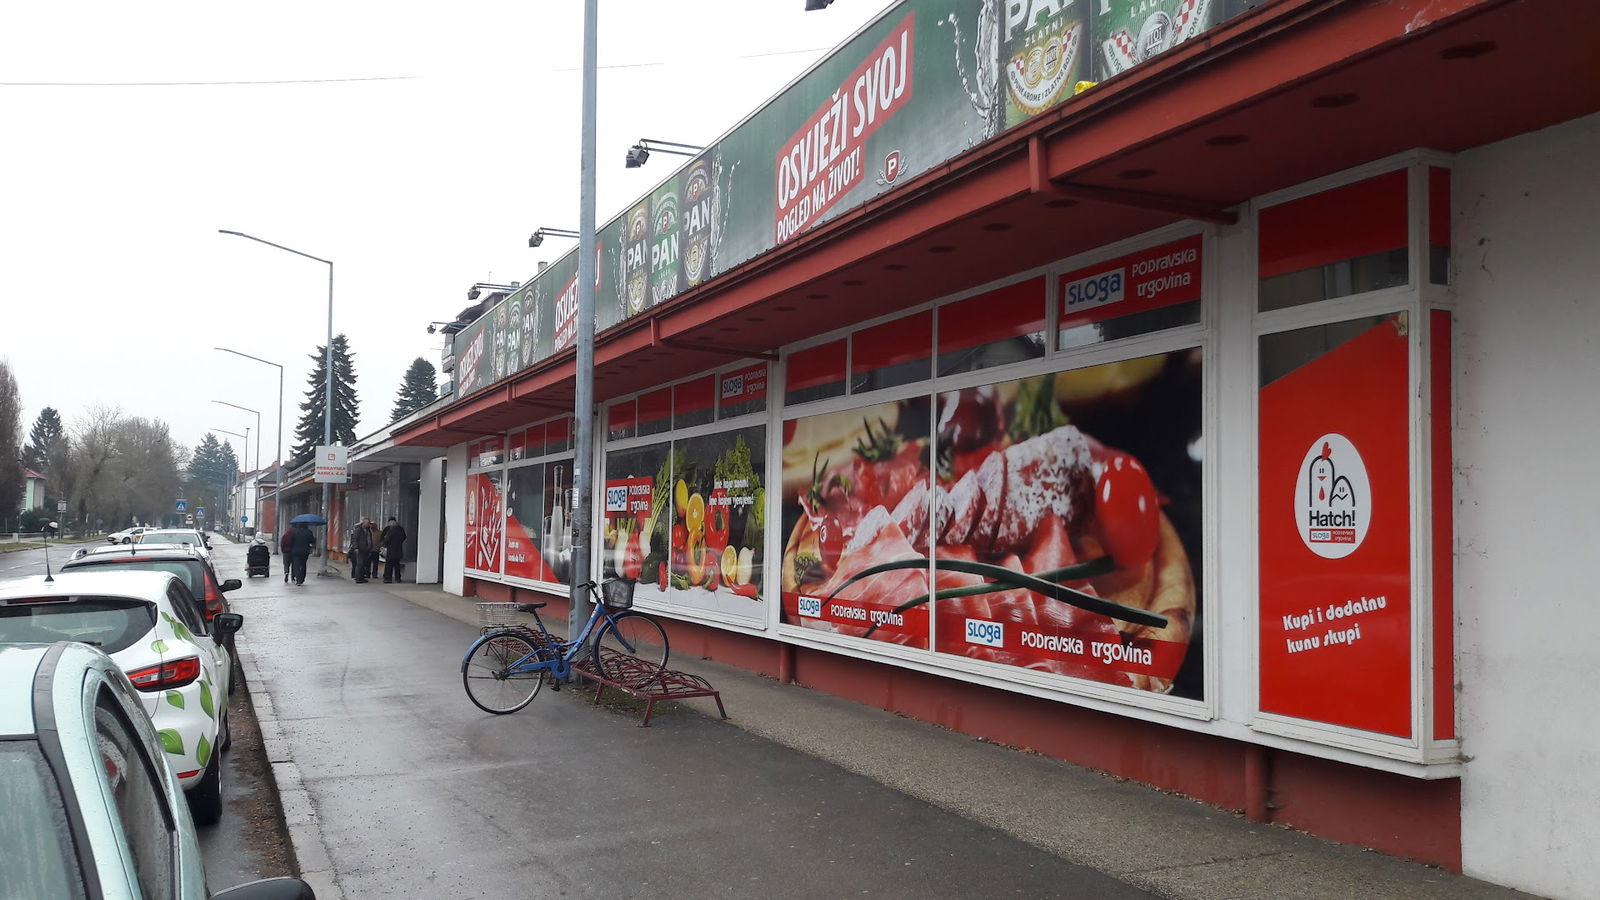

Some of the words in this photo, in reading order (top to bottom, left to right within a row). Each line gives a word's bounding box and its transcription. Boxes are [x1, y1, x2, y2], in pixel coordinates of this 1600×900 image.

[1003, 0, 1075, 43] PA
[1024, 17, 1063, 48] ZLATNI
[778, 88, 848, 210] OSVJEŽI
[853, 30, 908, 137] SVOJ
[888, 157, 897, 176] P
[777, 194, 810, 244] POGLED
[812, 184, 825, 216] NA
[828, 146, 860, 202] ŽIVOT!
[651, 231, 680, 273] PAN
[1137, 271, 1191, 298] trgovina
[555, 270, 579, 333] OSVJEŽ
[507, 328, 520, 352] PAN
[1309, 510, 1355, 526] Hatch!
[870, 609, 903, 626] trgovina
[1282, 609, 1315, 631] Kupi
[1317, 607, 1323, 623] i
[1326, 595, 1387, 621] dodatnu
[1091, 641, 1152, 665] trgovina
[1286, 636, 1320, 653] kunu
[1323, 623, 1361, 647] skupi
